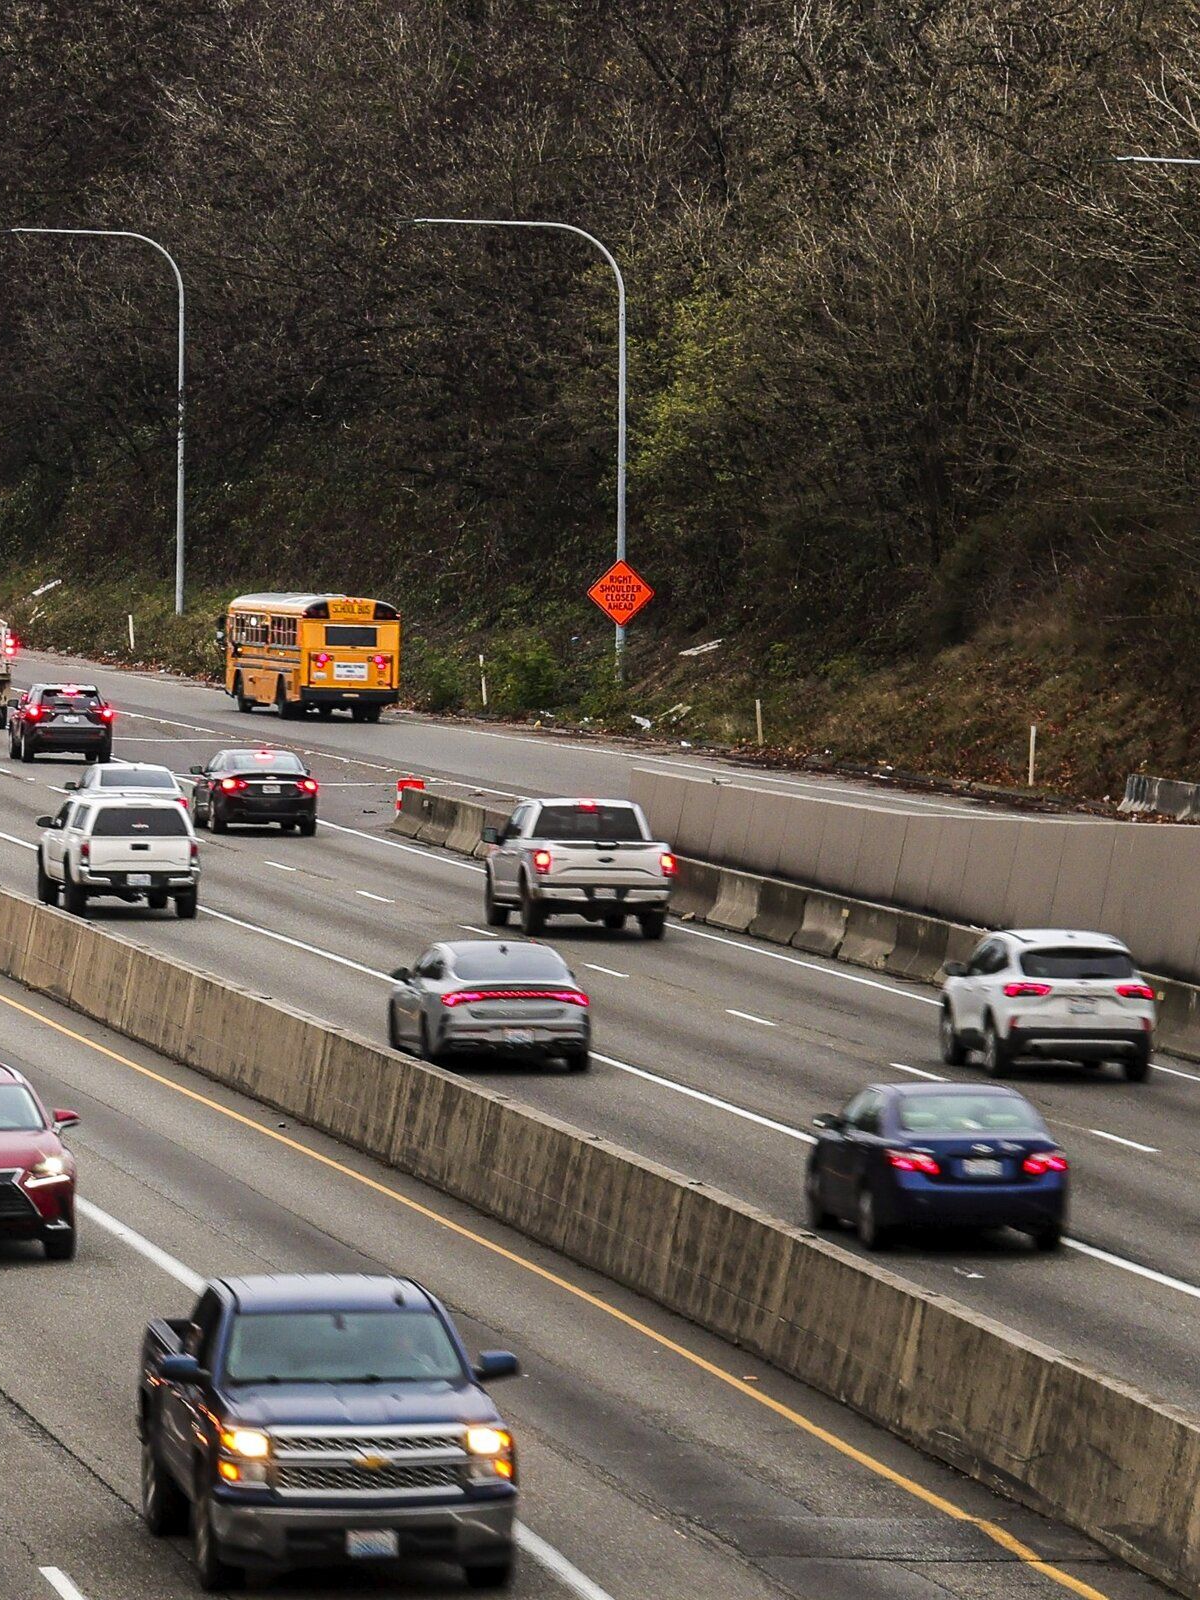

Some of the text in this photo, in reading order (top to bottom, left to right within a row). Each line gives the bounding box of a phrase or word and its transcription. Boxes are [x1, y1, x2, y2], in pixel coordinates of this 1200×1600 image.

[610, 576, 632, 584] RIGHT
[332, 604, 370, 614] SCHOOL BUS
[608, 602, 634, 610] AHEAD
